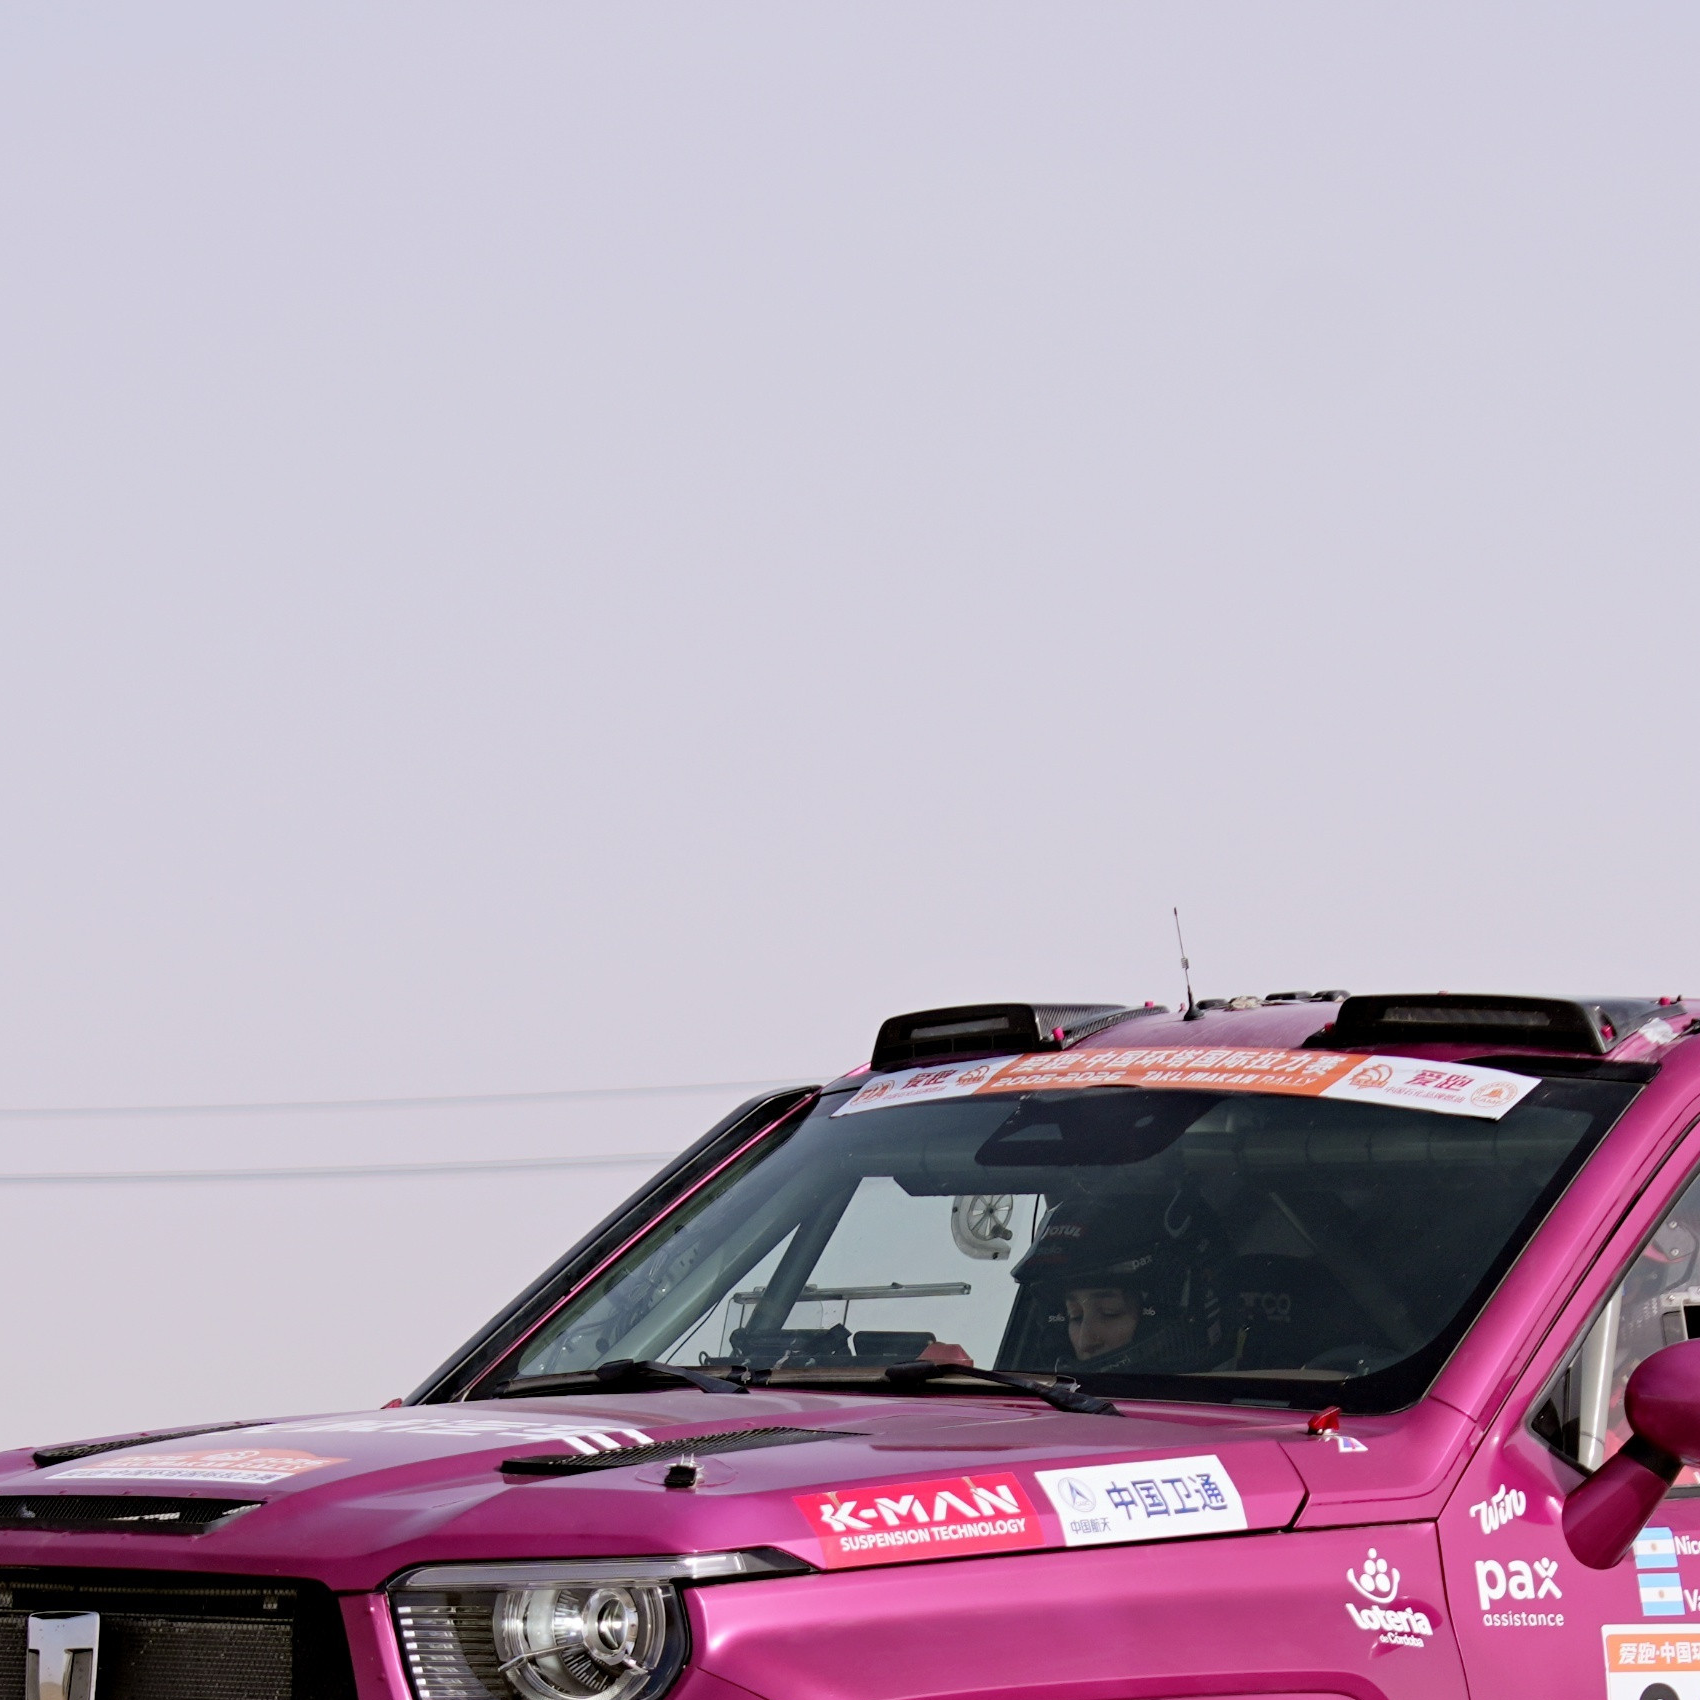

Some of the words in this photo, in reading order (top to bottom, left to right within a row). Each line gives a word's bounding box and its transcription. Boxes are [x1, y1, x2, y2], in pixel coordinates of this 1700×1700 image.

[991, 1070, 1127, 1089] 2005-2026
[1140, 1070, 1261, 1085] TAKLIMAKAN
[1257, 1075, 1318, 1087] RALLY
[1403, 1069, 1476, 1092] 爱跑
[820, 1485, 1022, 1533] K-MAN
[1105, 1472, 1229, 1522] 中国卫通
[840, 1524, 929, 1552] SUSPENSION
[929, 1517, 1027, 1547] TECHNOLOGY
[1474, 1556, 1563, 1611] pax
[1483, 1610, 1565, 1627] assistance
